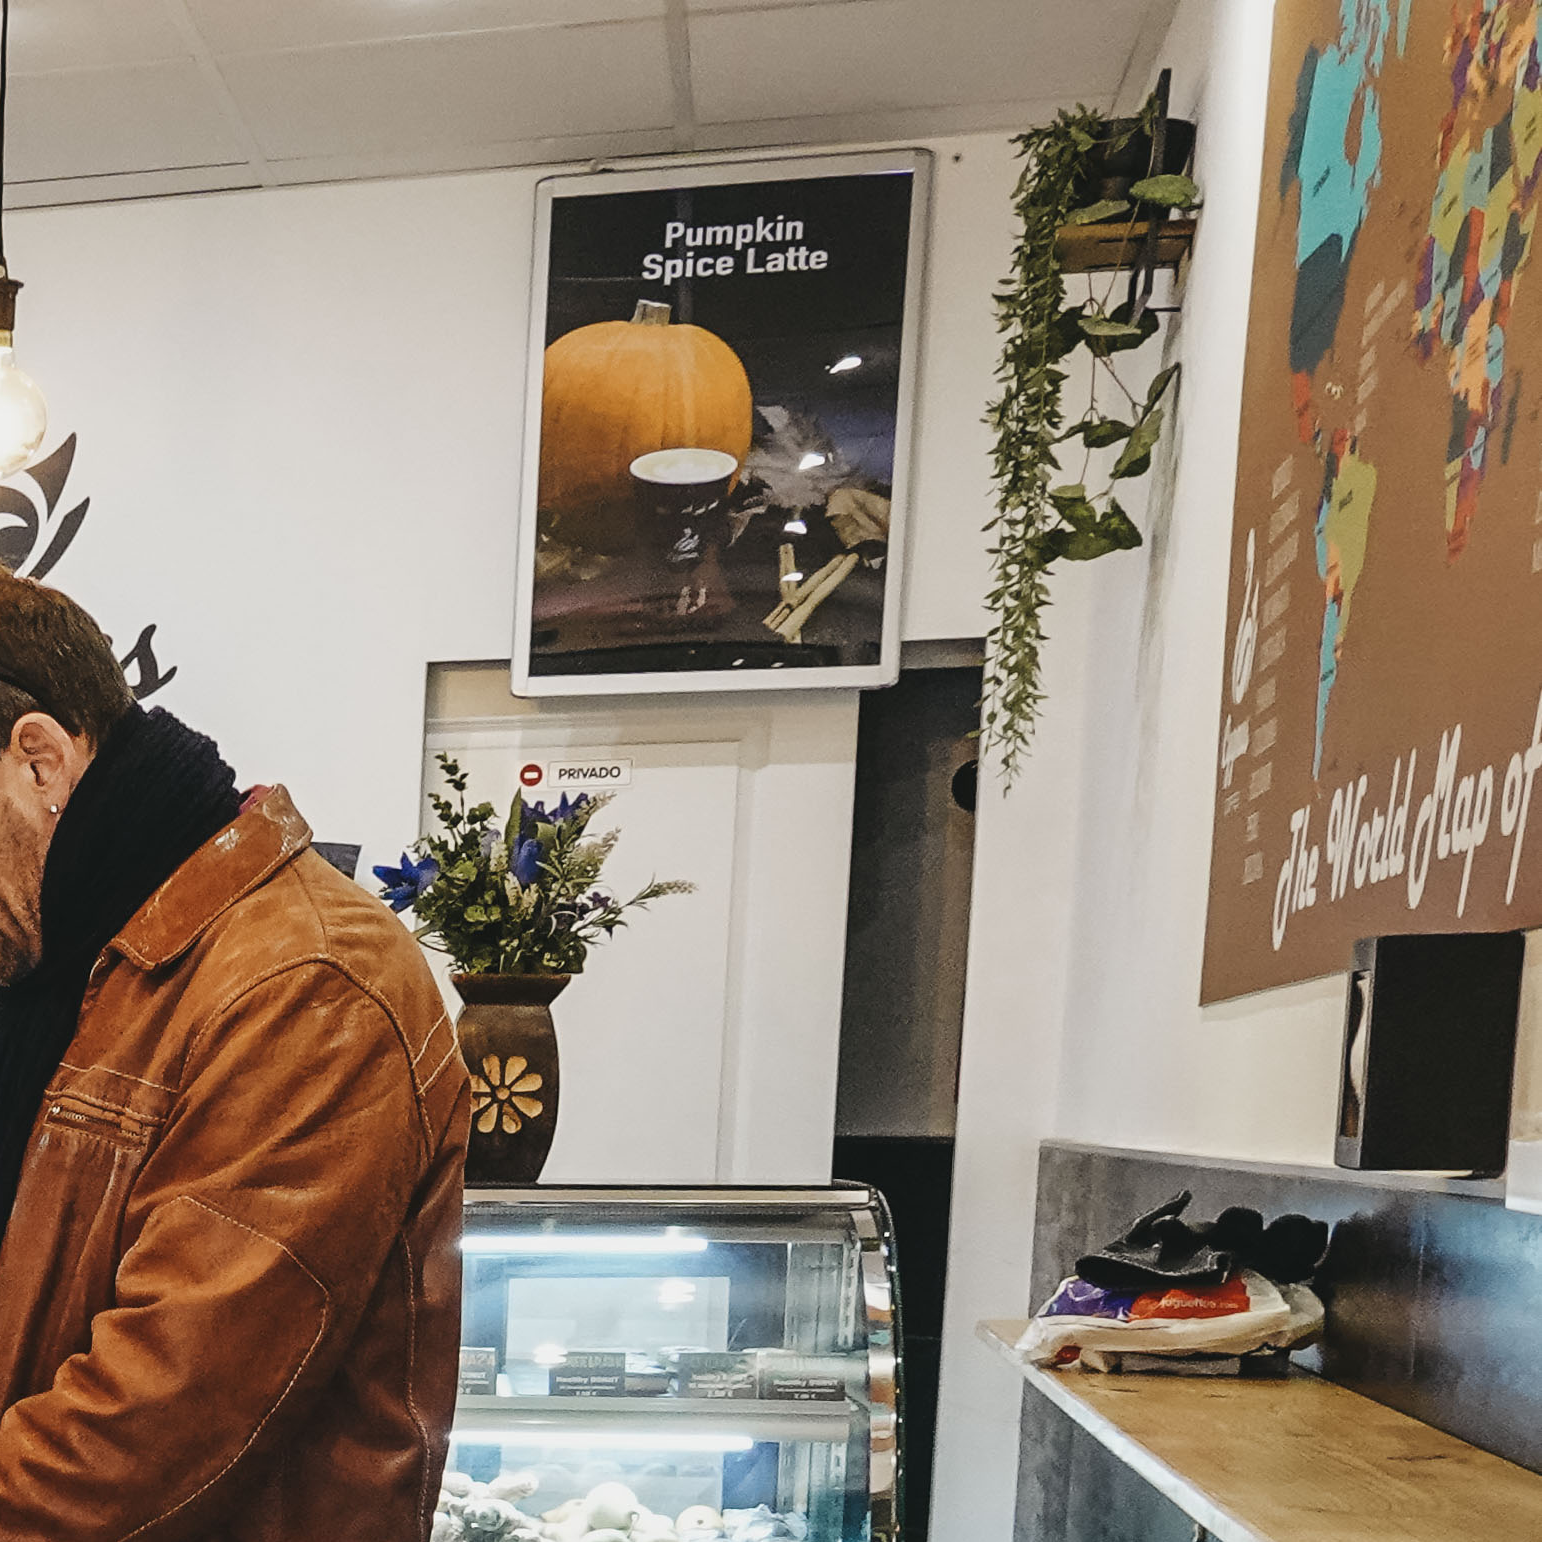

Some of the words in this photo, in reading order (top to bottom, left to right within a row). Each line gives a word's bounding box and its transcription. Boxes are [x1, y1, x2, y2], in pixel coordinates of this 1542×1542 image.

[665, 215, 804, 252] Pumpkin
[642, 251, 733, 285] Spice
[746, 246, 828, 274] Latte
[558, 764, 621, 781] PRIVADO
[1273, 805, 1319, 951] The
[1328, 749, 1416, 902] World
[1408, 724, 1494, 918] Map
